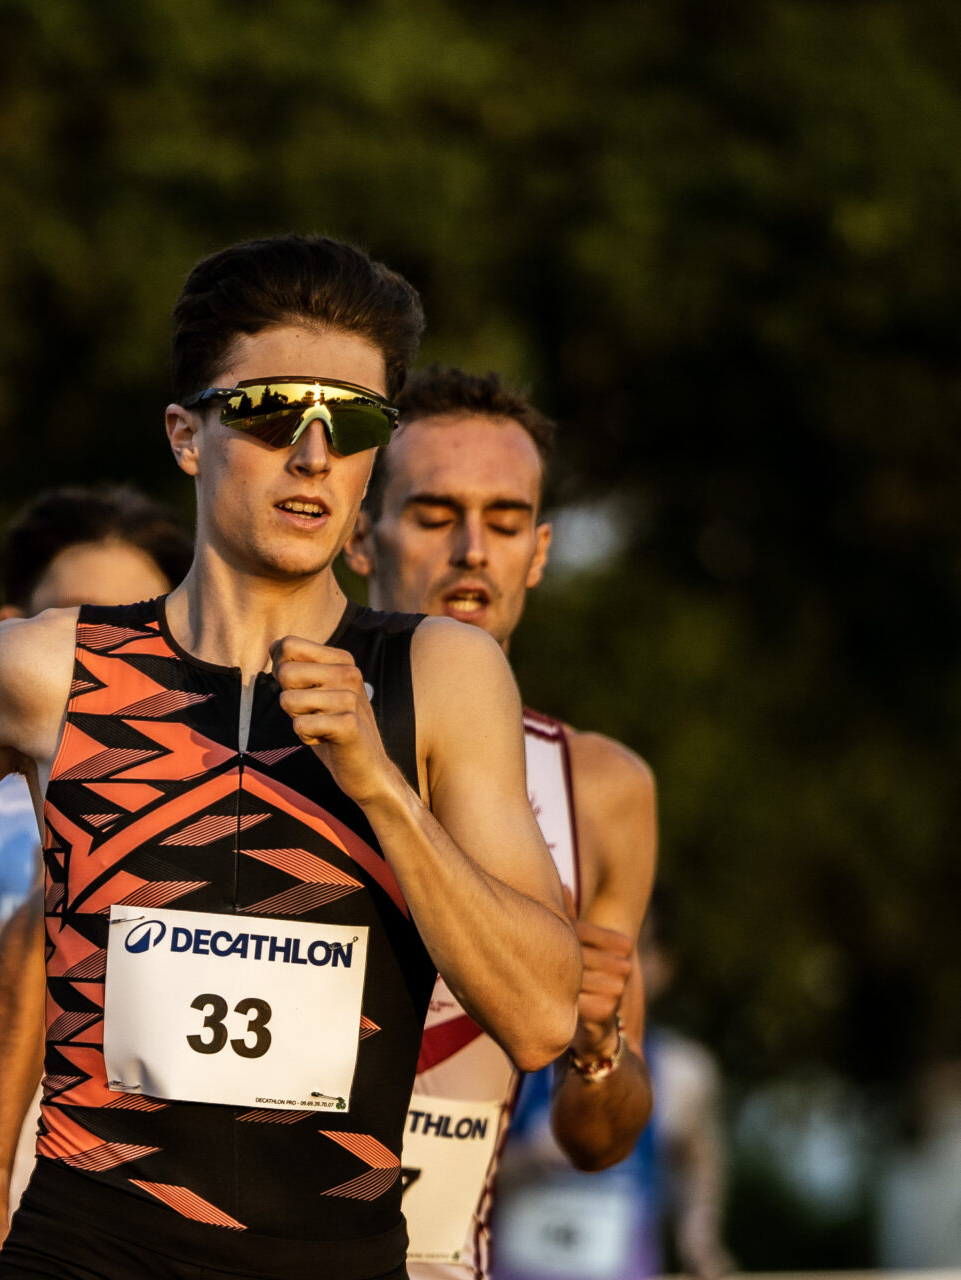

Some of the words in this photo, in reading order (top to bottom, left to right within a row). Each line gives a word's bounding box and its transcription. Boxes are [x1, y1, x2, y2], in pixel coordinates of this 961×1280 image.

[170, 926, 353, 968] DECATHLON
[186, 993, 273, 1059] 33
[255, 1097, 286, 1105] DECATHLON
[408, 1109, 489, 1140] THLON
[401, 1167, 422, 1199] 7
